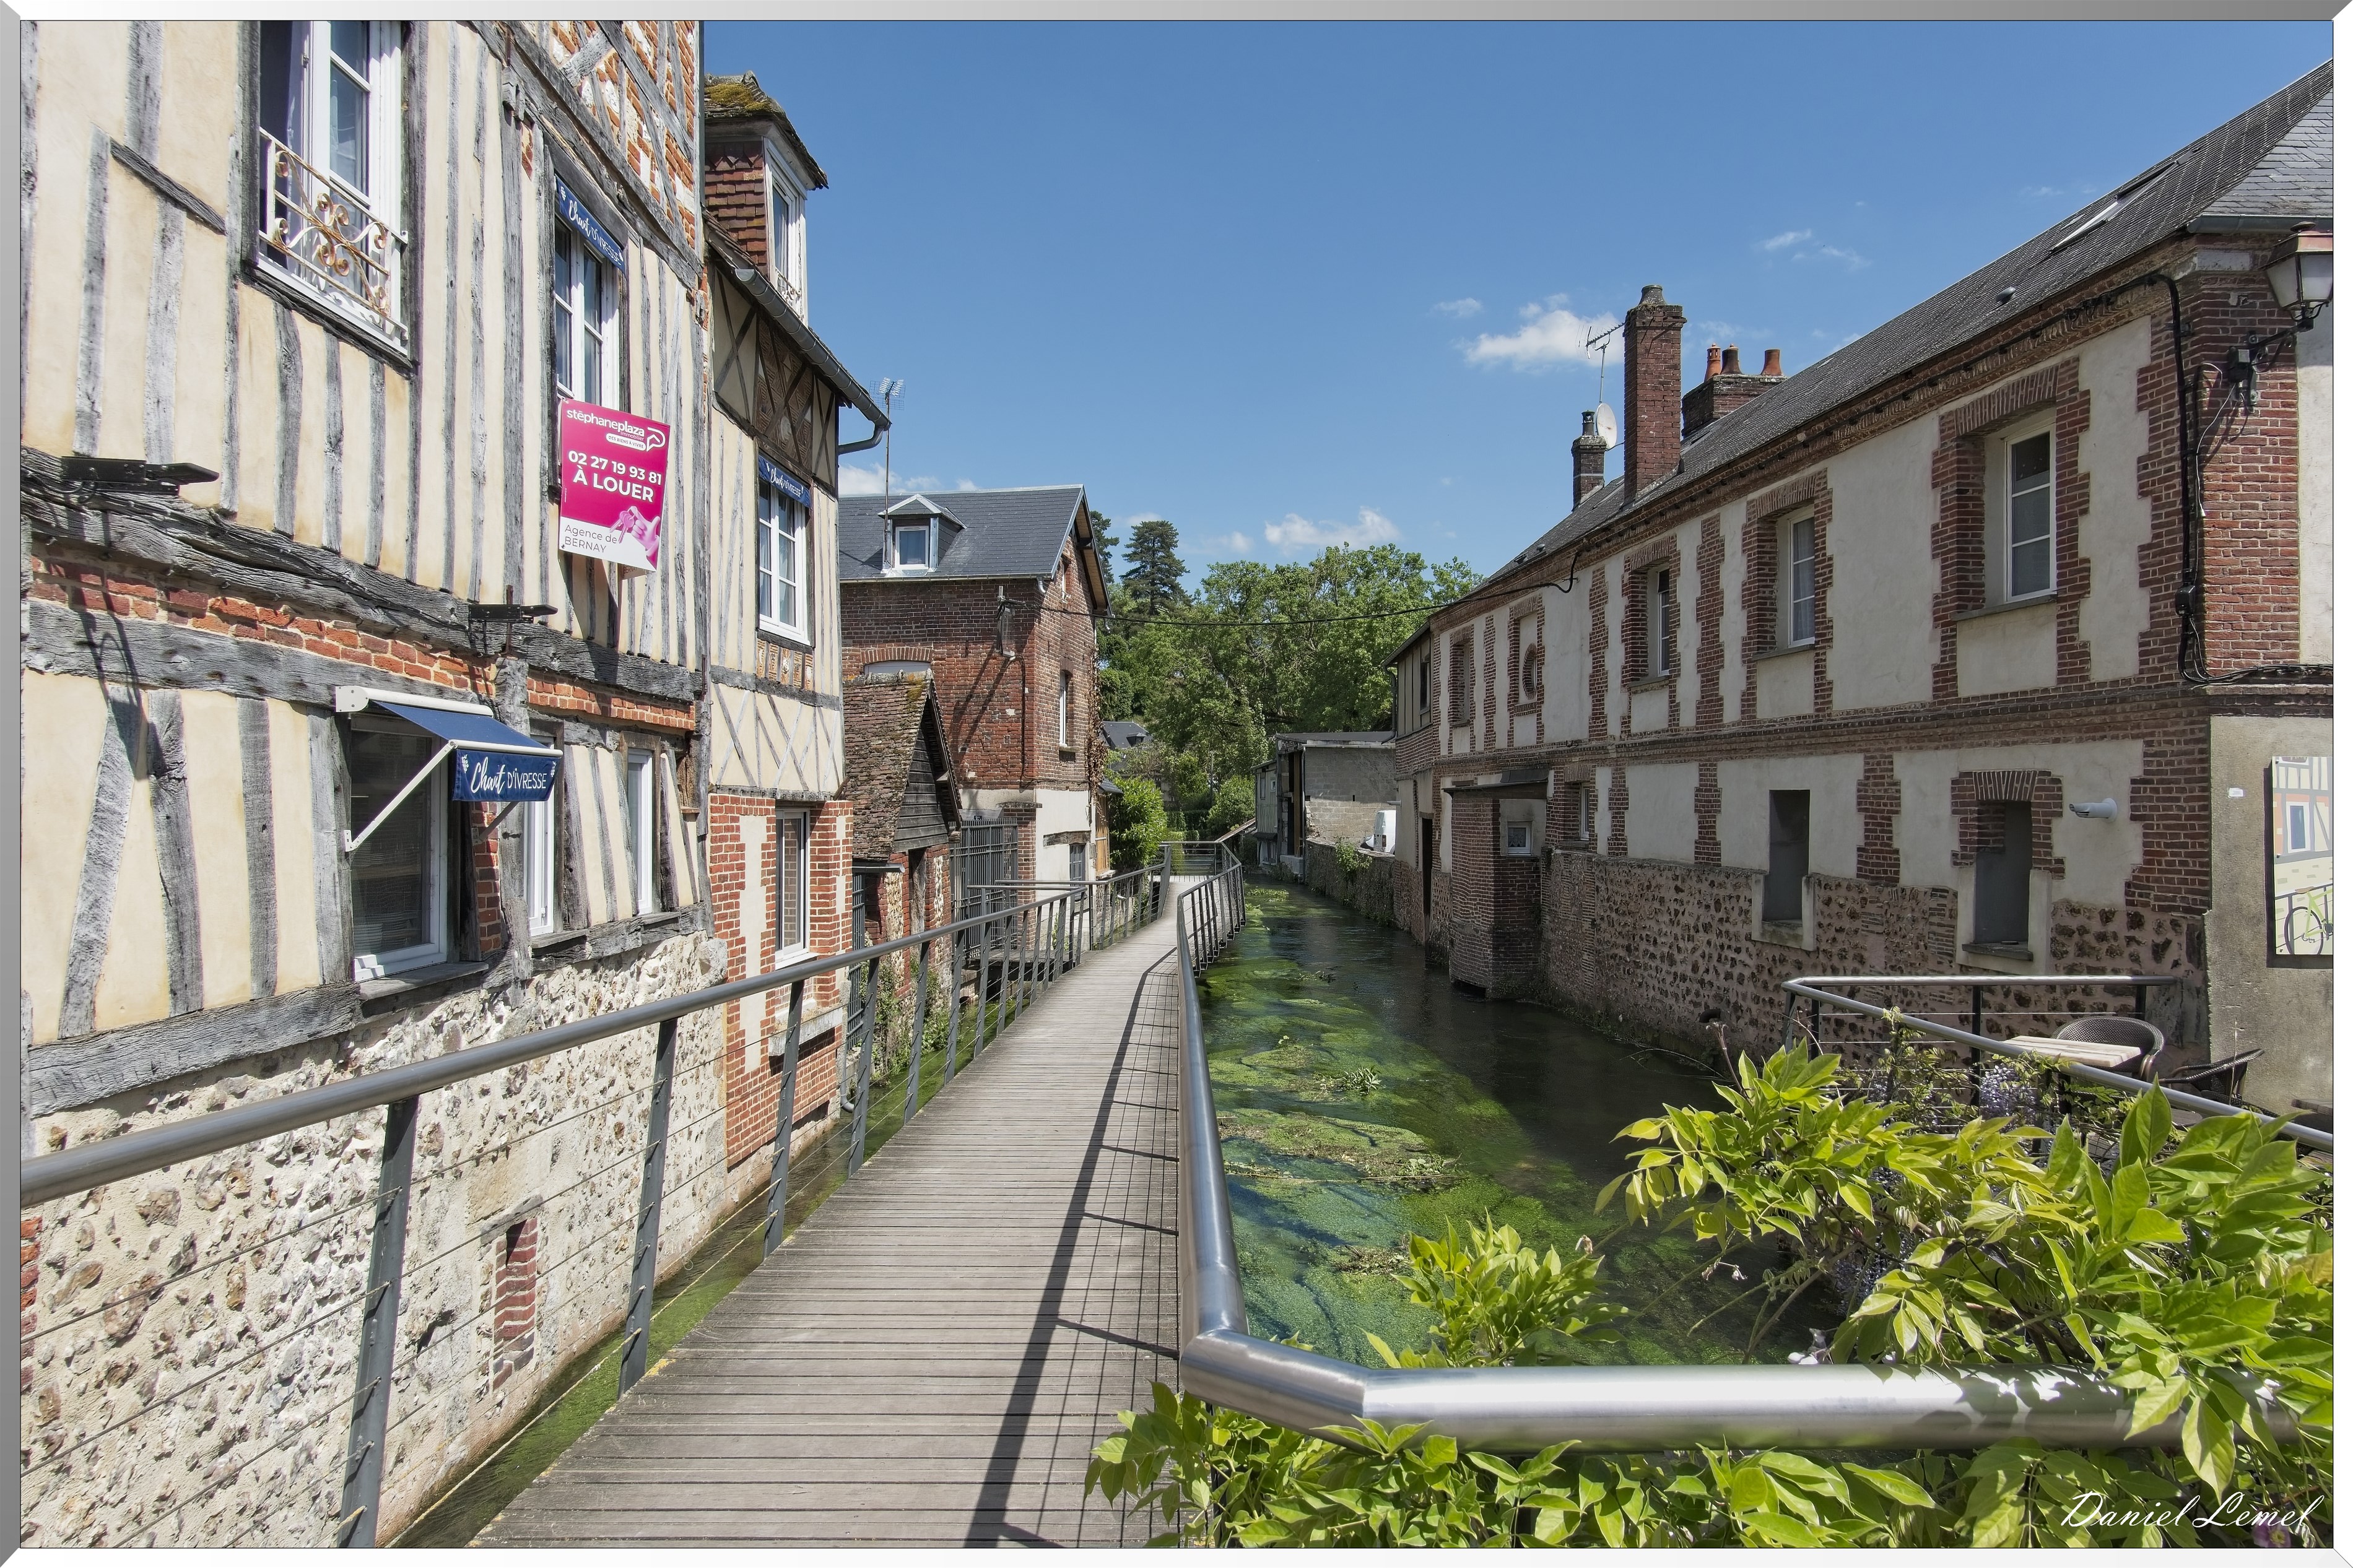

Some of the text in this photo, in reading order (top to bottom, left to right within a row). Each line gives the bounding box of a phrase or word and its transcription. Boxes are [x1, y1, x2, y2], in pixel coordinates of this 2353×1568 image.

[568, 451, 662, 485] 02 27 19 93 81
[573, 464, 588, 485] À
[593, 472, 654, 503] LOUER
[565, 524, 617, 544] Agence de
[565, 536, 607, 553] BERNAY
